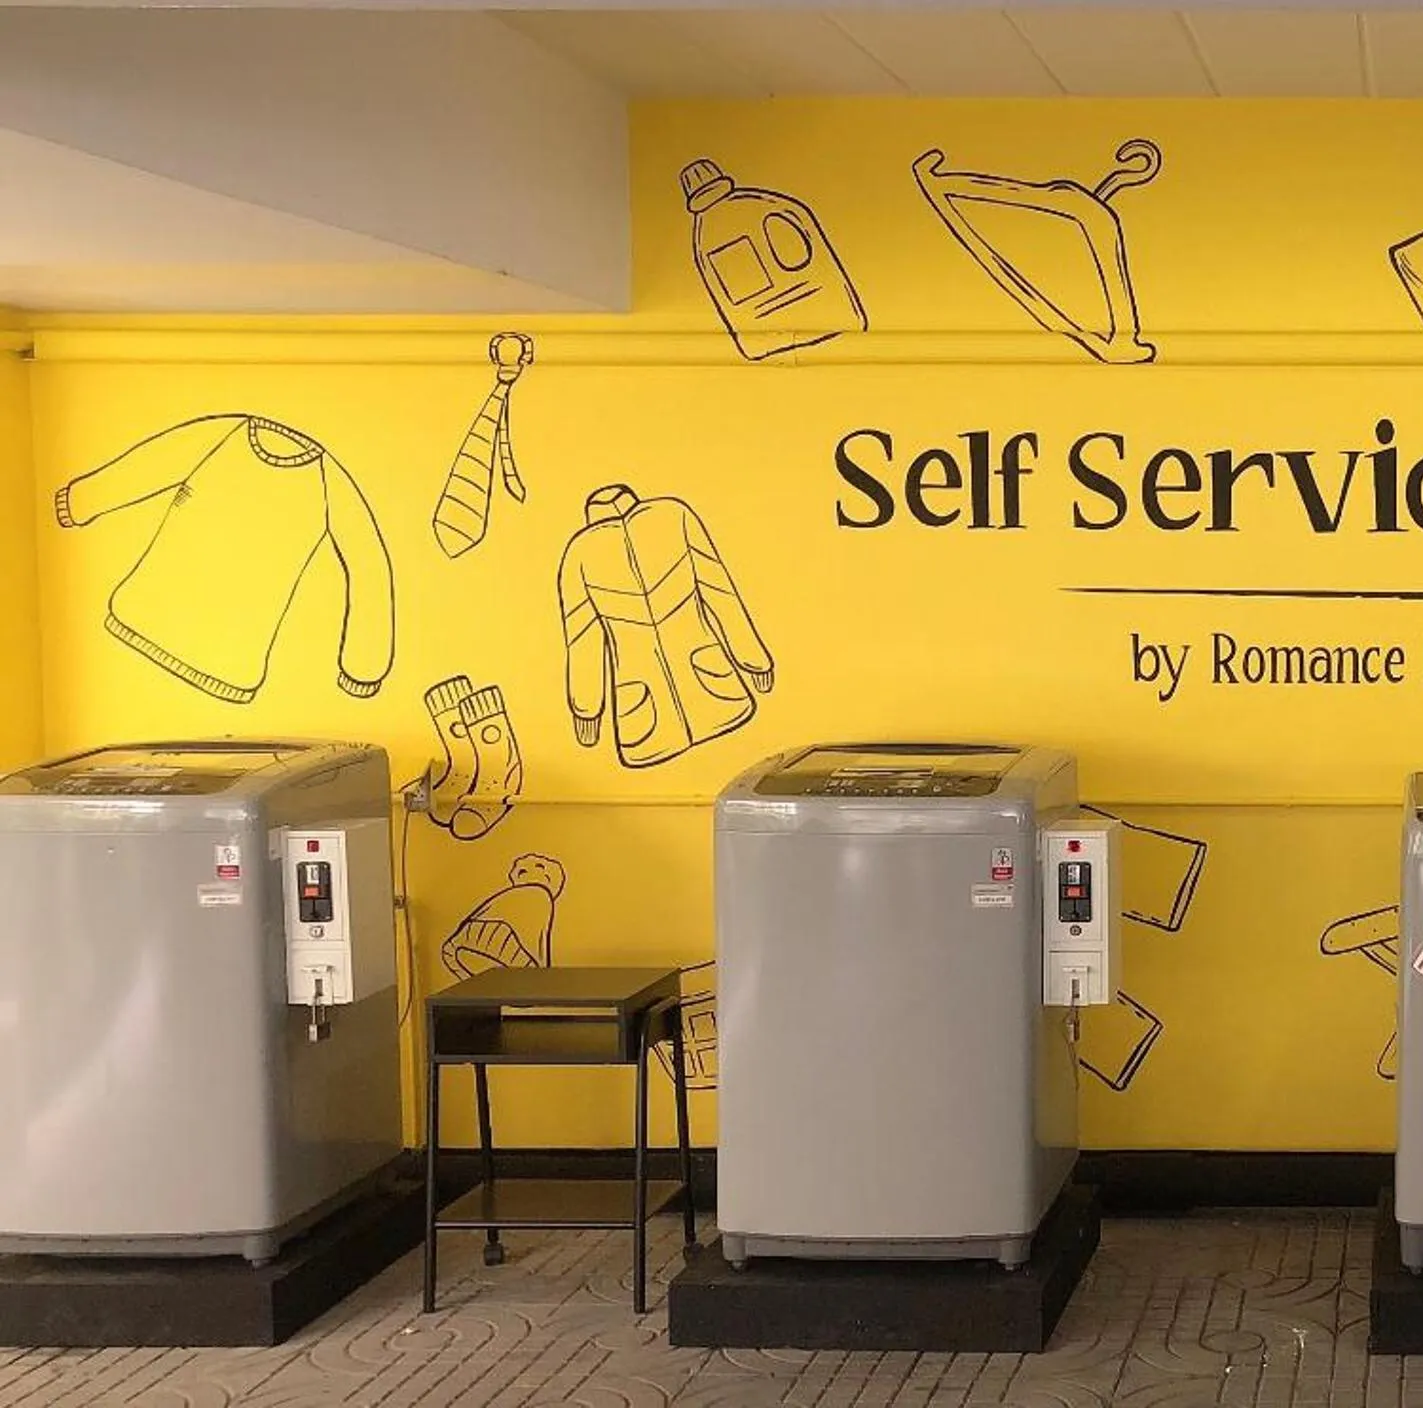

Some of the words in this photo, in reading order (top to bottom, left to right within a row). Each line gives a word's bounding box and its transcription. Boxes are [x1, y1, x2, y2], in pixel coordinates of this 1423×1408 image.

[835, 430, 1037, 530] Self
[1132, 634, 1187, 702] by
[1212, 634, 1405, 684] Romance
